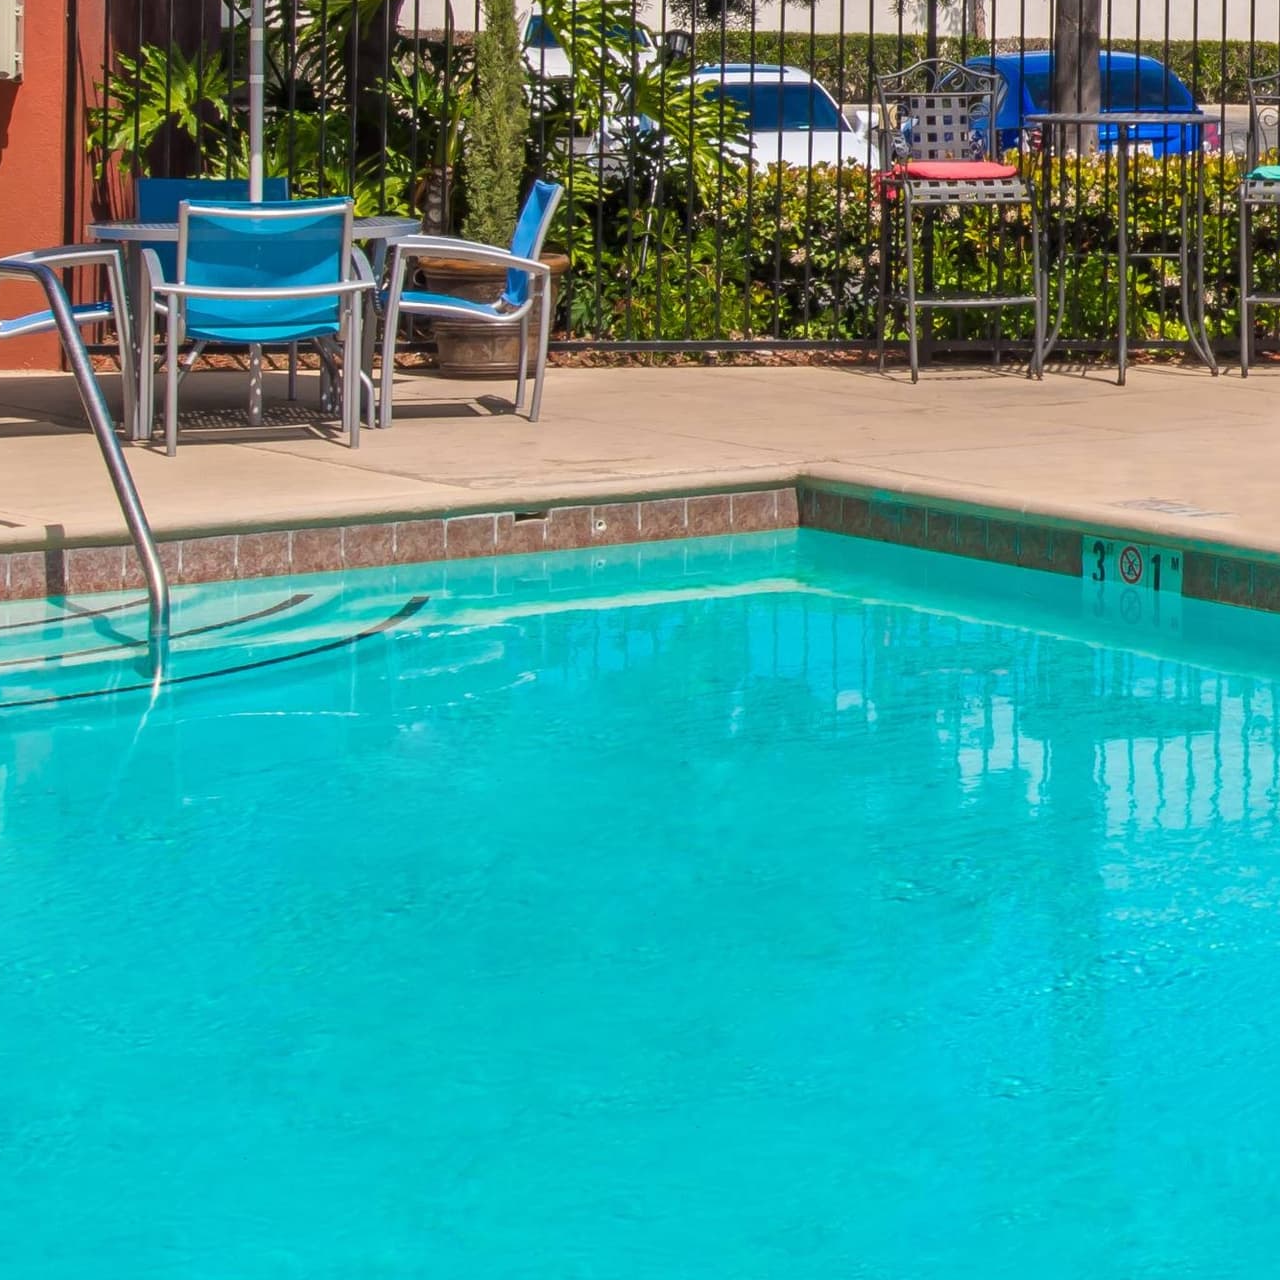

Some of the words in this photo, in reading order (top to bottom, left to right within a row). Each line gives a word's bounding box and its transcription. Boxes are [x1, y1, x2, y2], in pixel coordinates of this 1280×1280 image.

[1092, 540, 1105, 582] 3
[1151, 554, 1161, 592] 1
[1172, 557, 1179, 569] M
